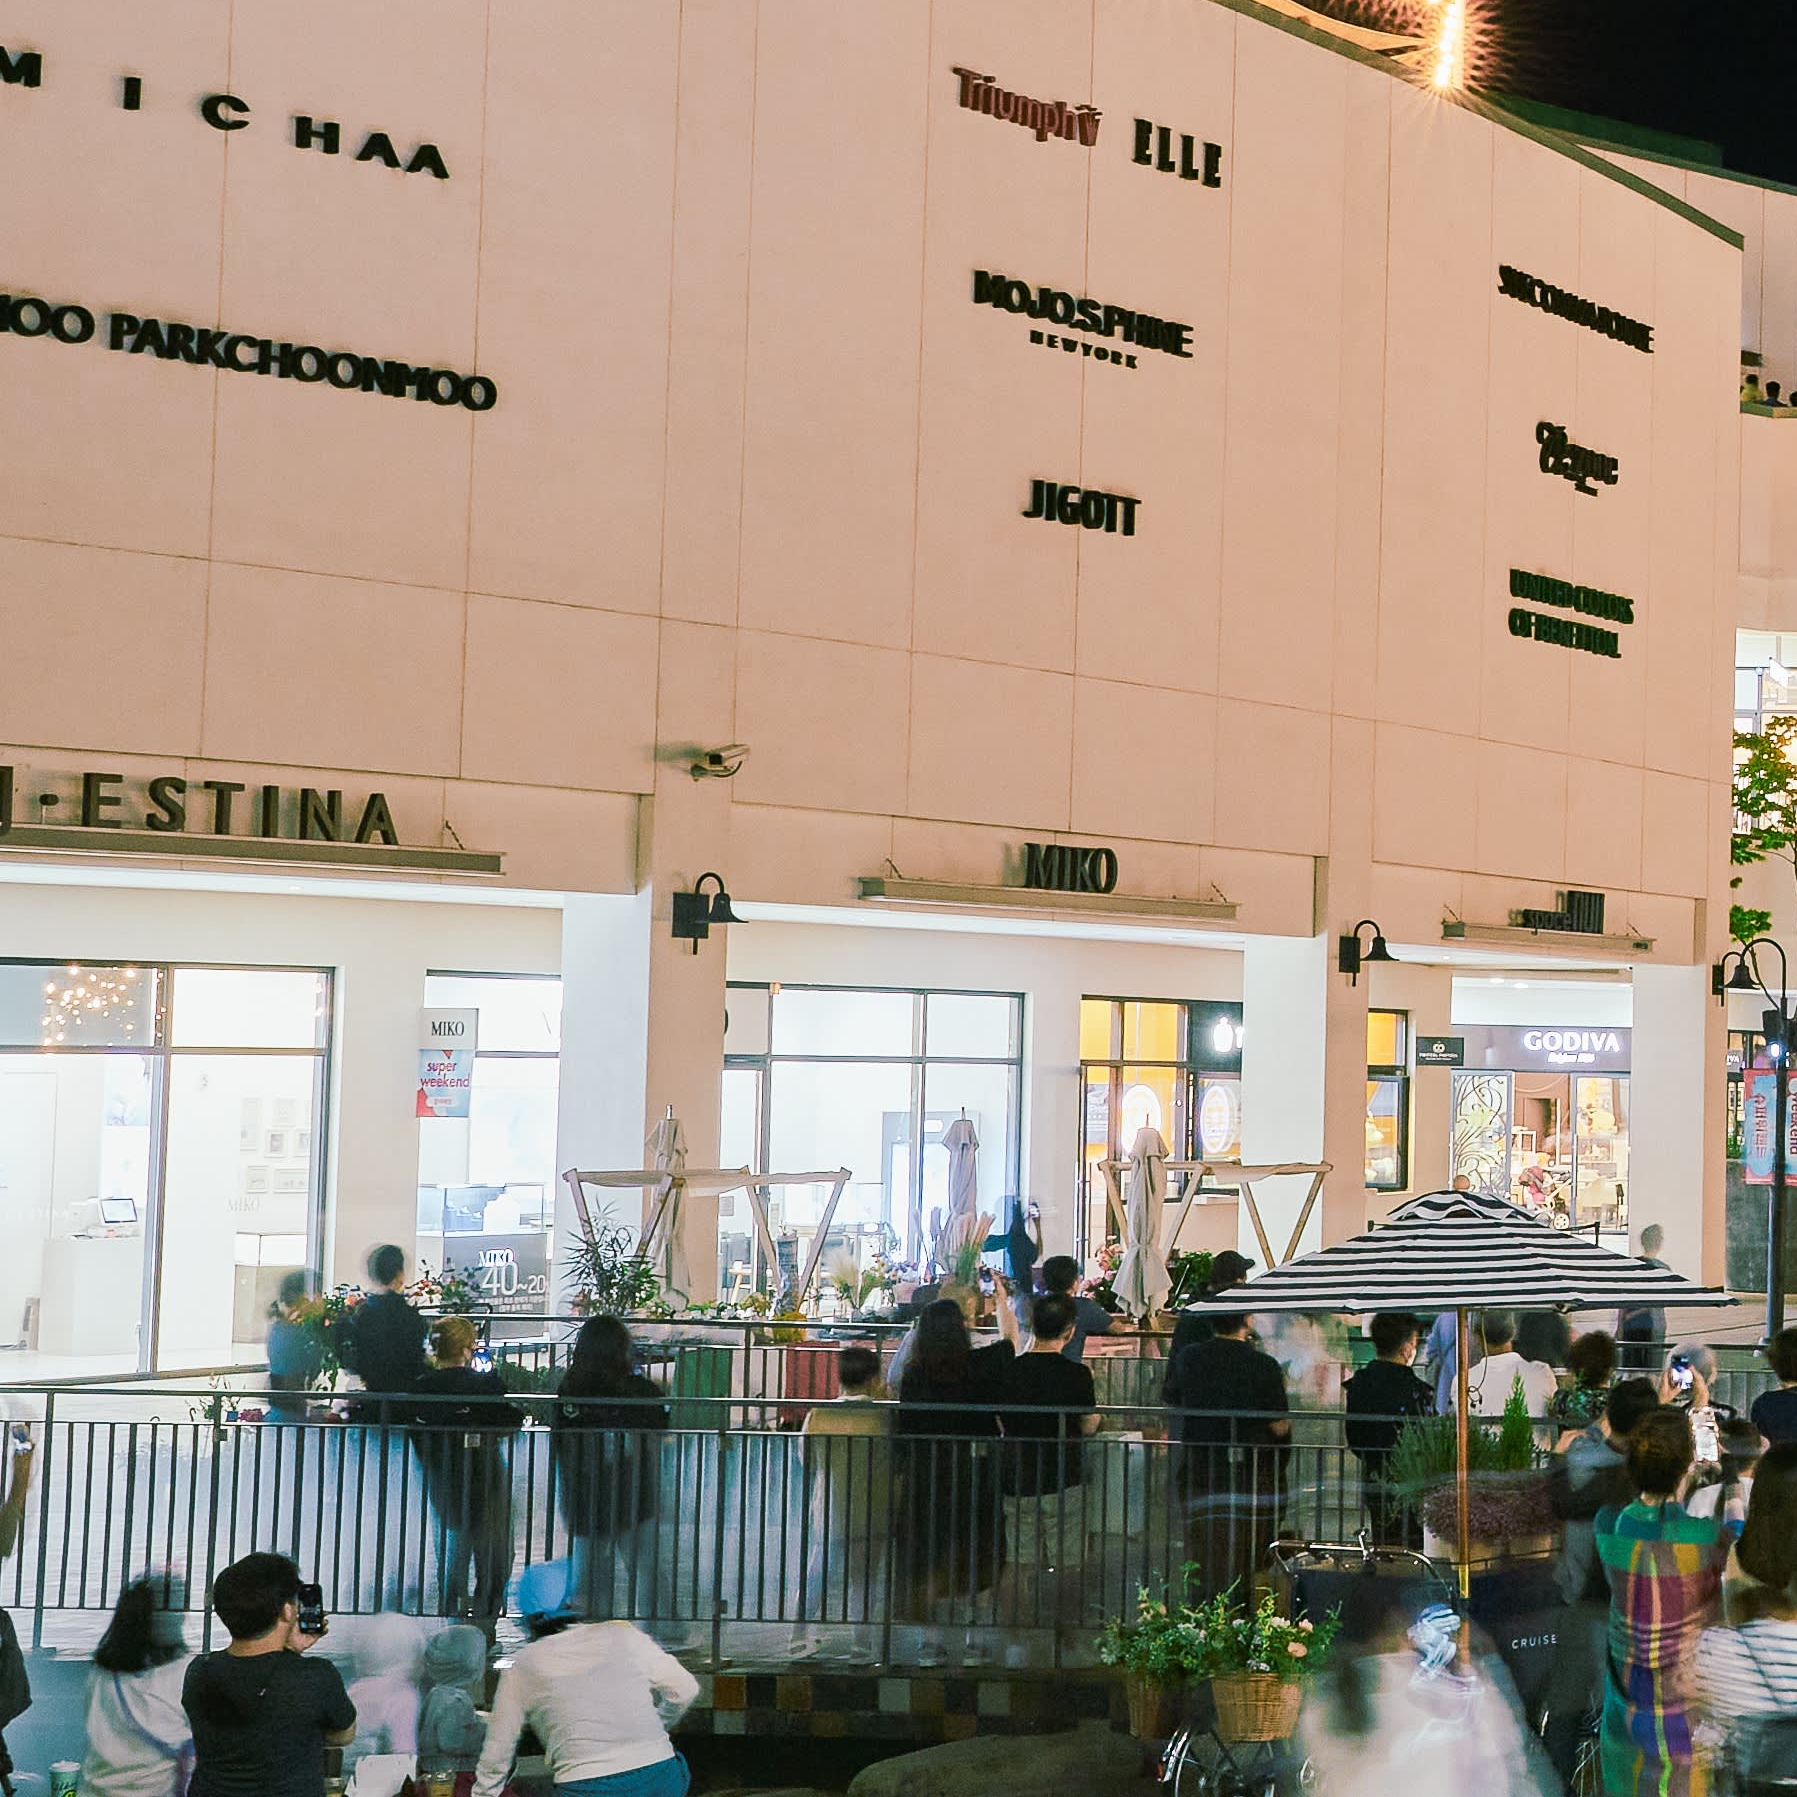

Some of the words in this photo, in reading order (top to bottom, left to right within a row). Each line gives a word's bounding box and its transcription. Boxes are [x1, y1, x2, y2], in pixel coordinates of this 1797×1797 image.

[952, 67, 1077, 142] Triumph
[1132, 118, 1222, 188] ELLE
[108, 312, 498, 412] PARKCHOONMOO
[1021, 479, 1142, 536] JIGOTT
[1023, 842, 1118, 894] MIKO
[431, 1020, 465, 1037] MIKO
[1523, 1030, 1621, 1053] GODIVA
[426, 1061, 457, 1075] super
[420, 1072, 471, 1088] weekend
[478, 1248, 514, 1267] MIKO
[1511, 1634, 1559, 1649] CRUISE
